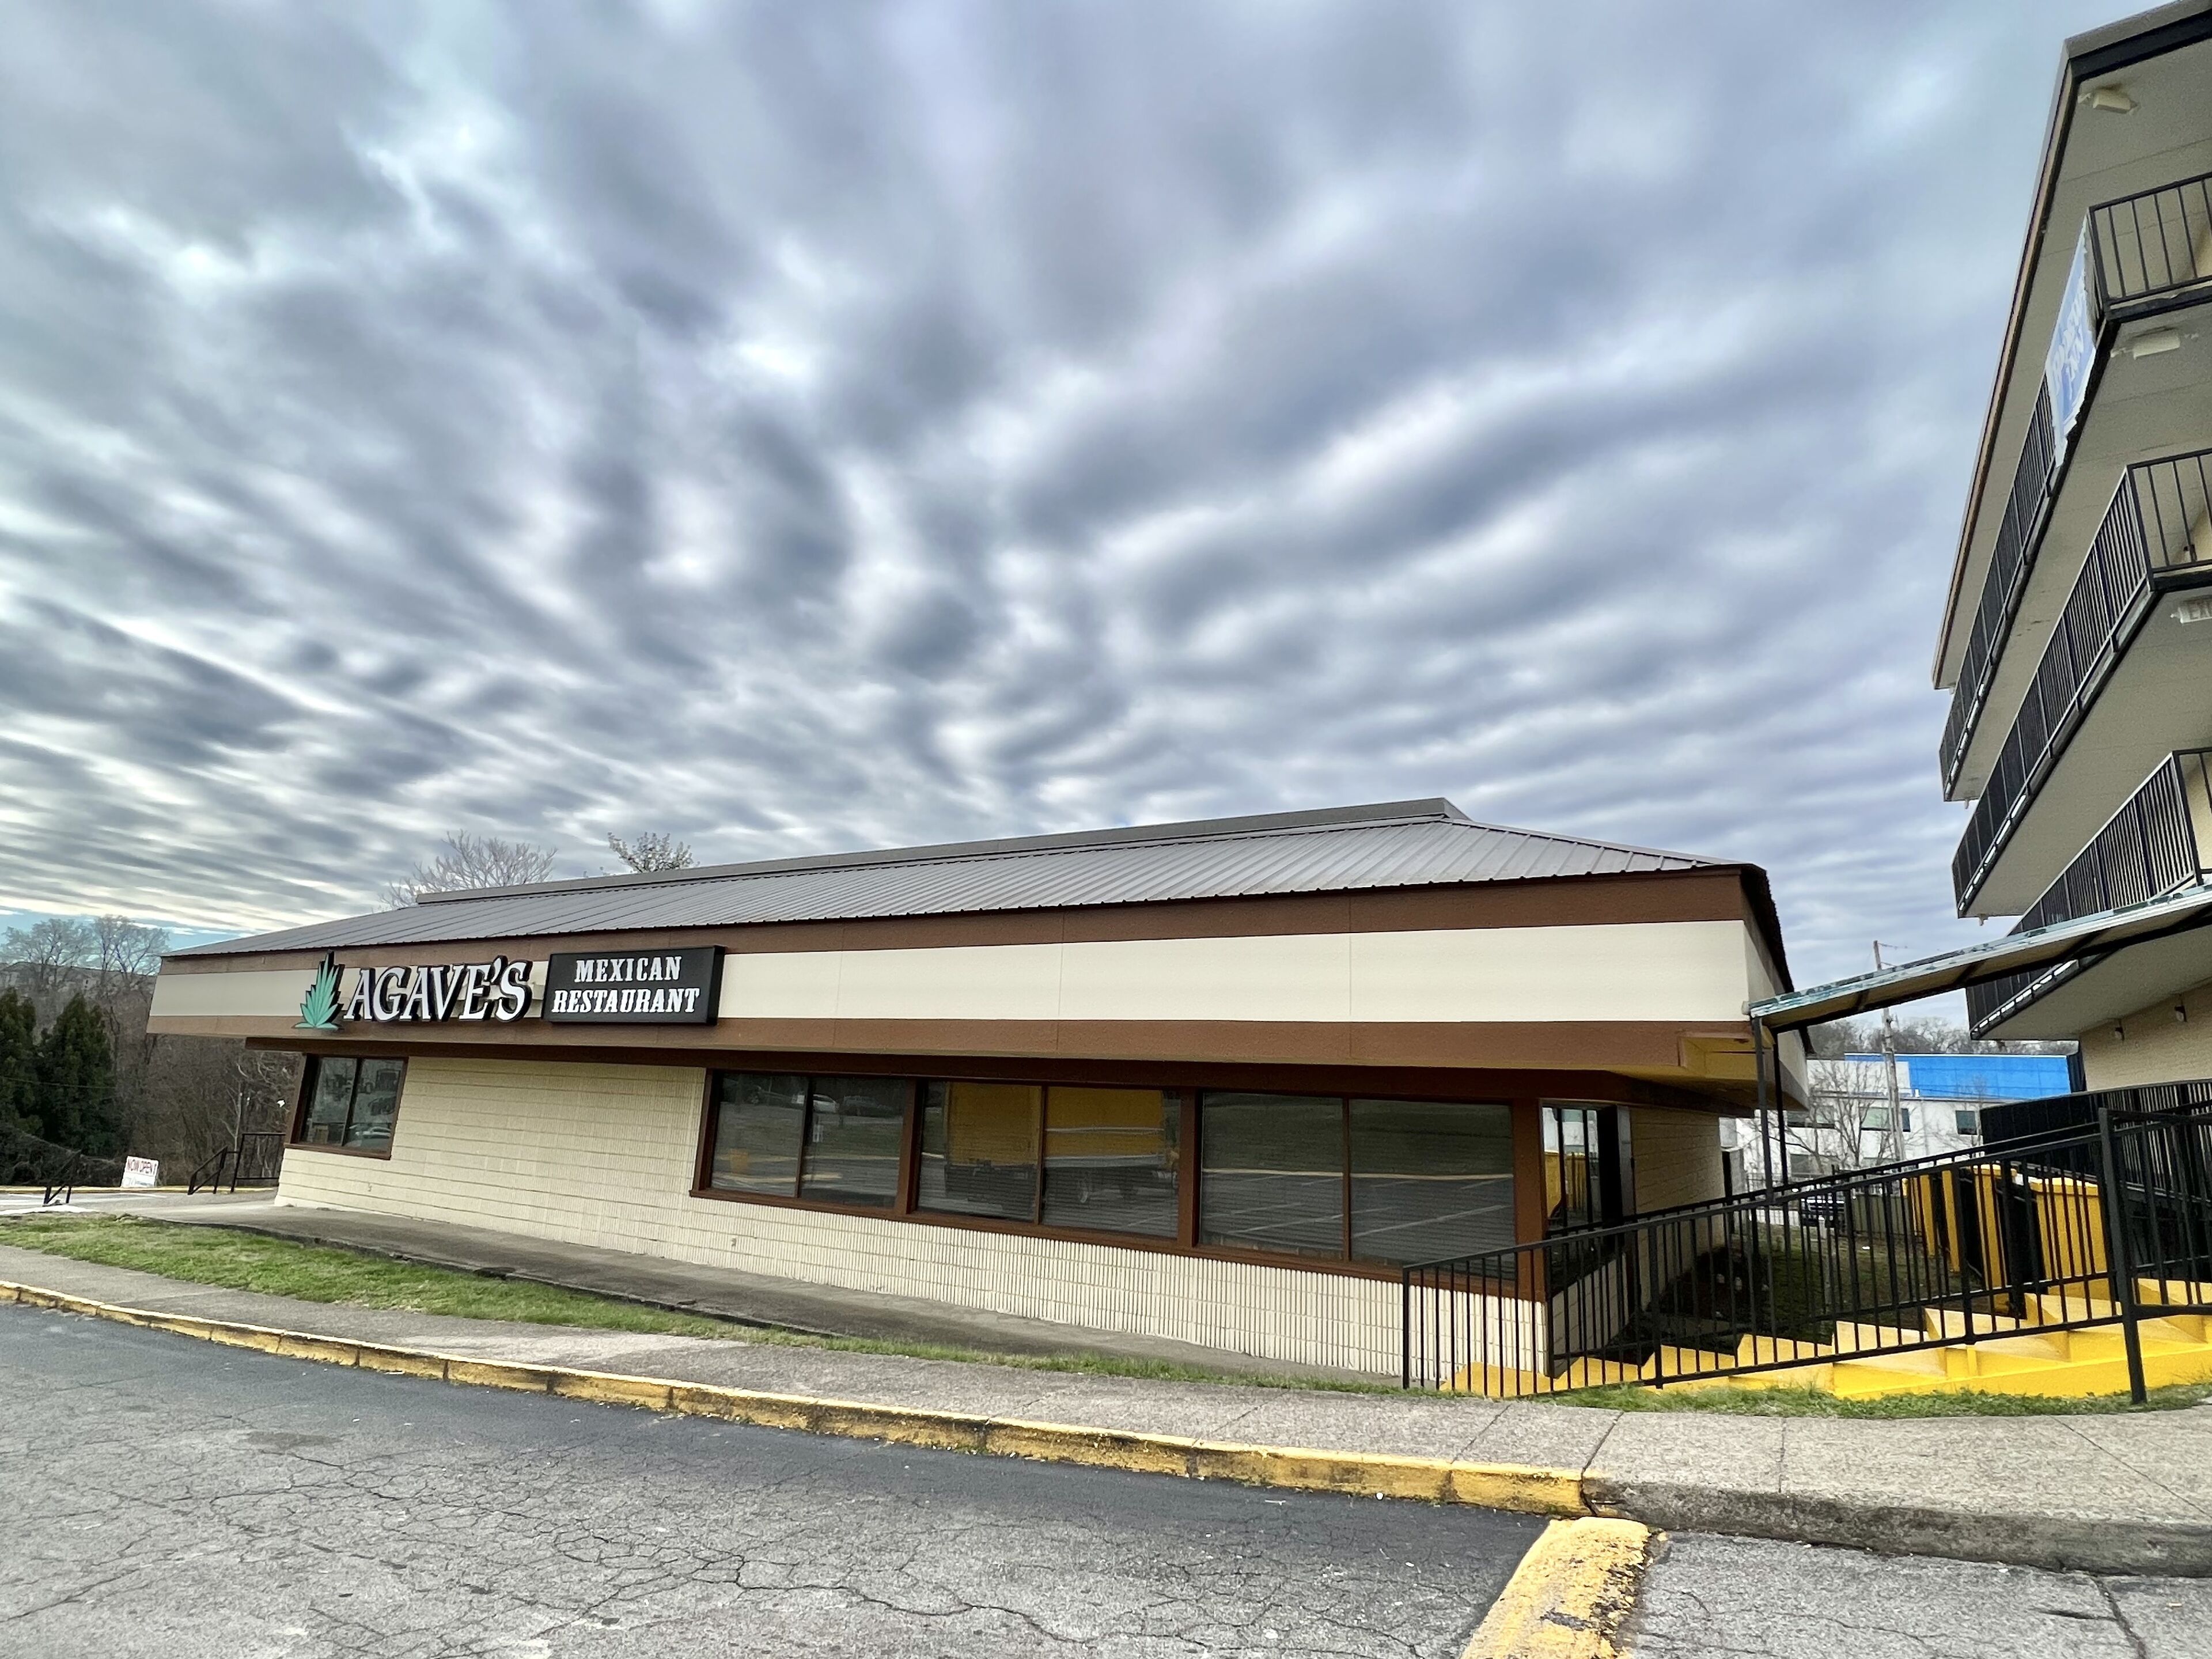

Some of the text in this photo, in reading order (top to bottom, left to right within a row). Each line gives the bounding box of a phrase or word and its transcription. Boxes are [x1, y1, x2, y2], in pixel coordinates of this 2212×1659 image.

[574, 956, 682, 982] MEXICAN
[343, 956, 532, 1021] AGAVE'S
[551, 988, 700, 1013] RESTAURANT
